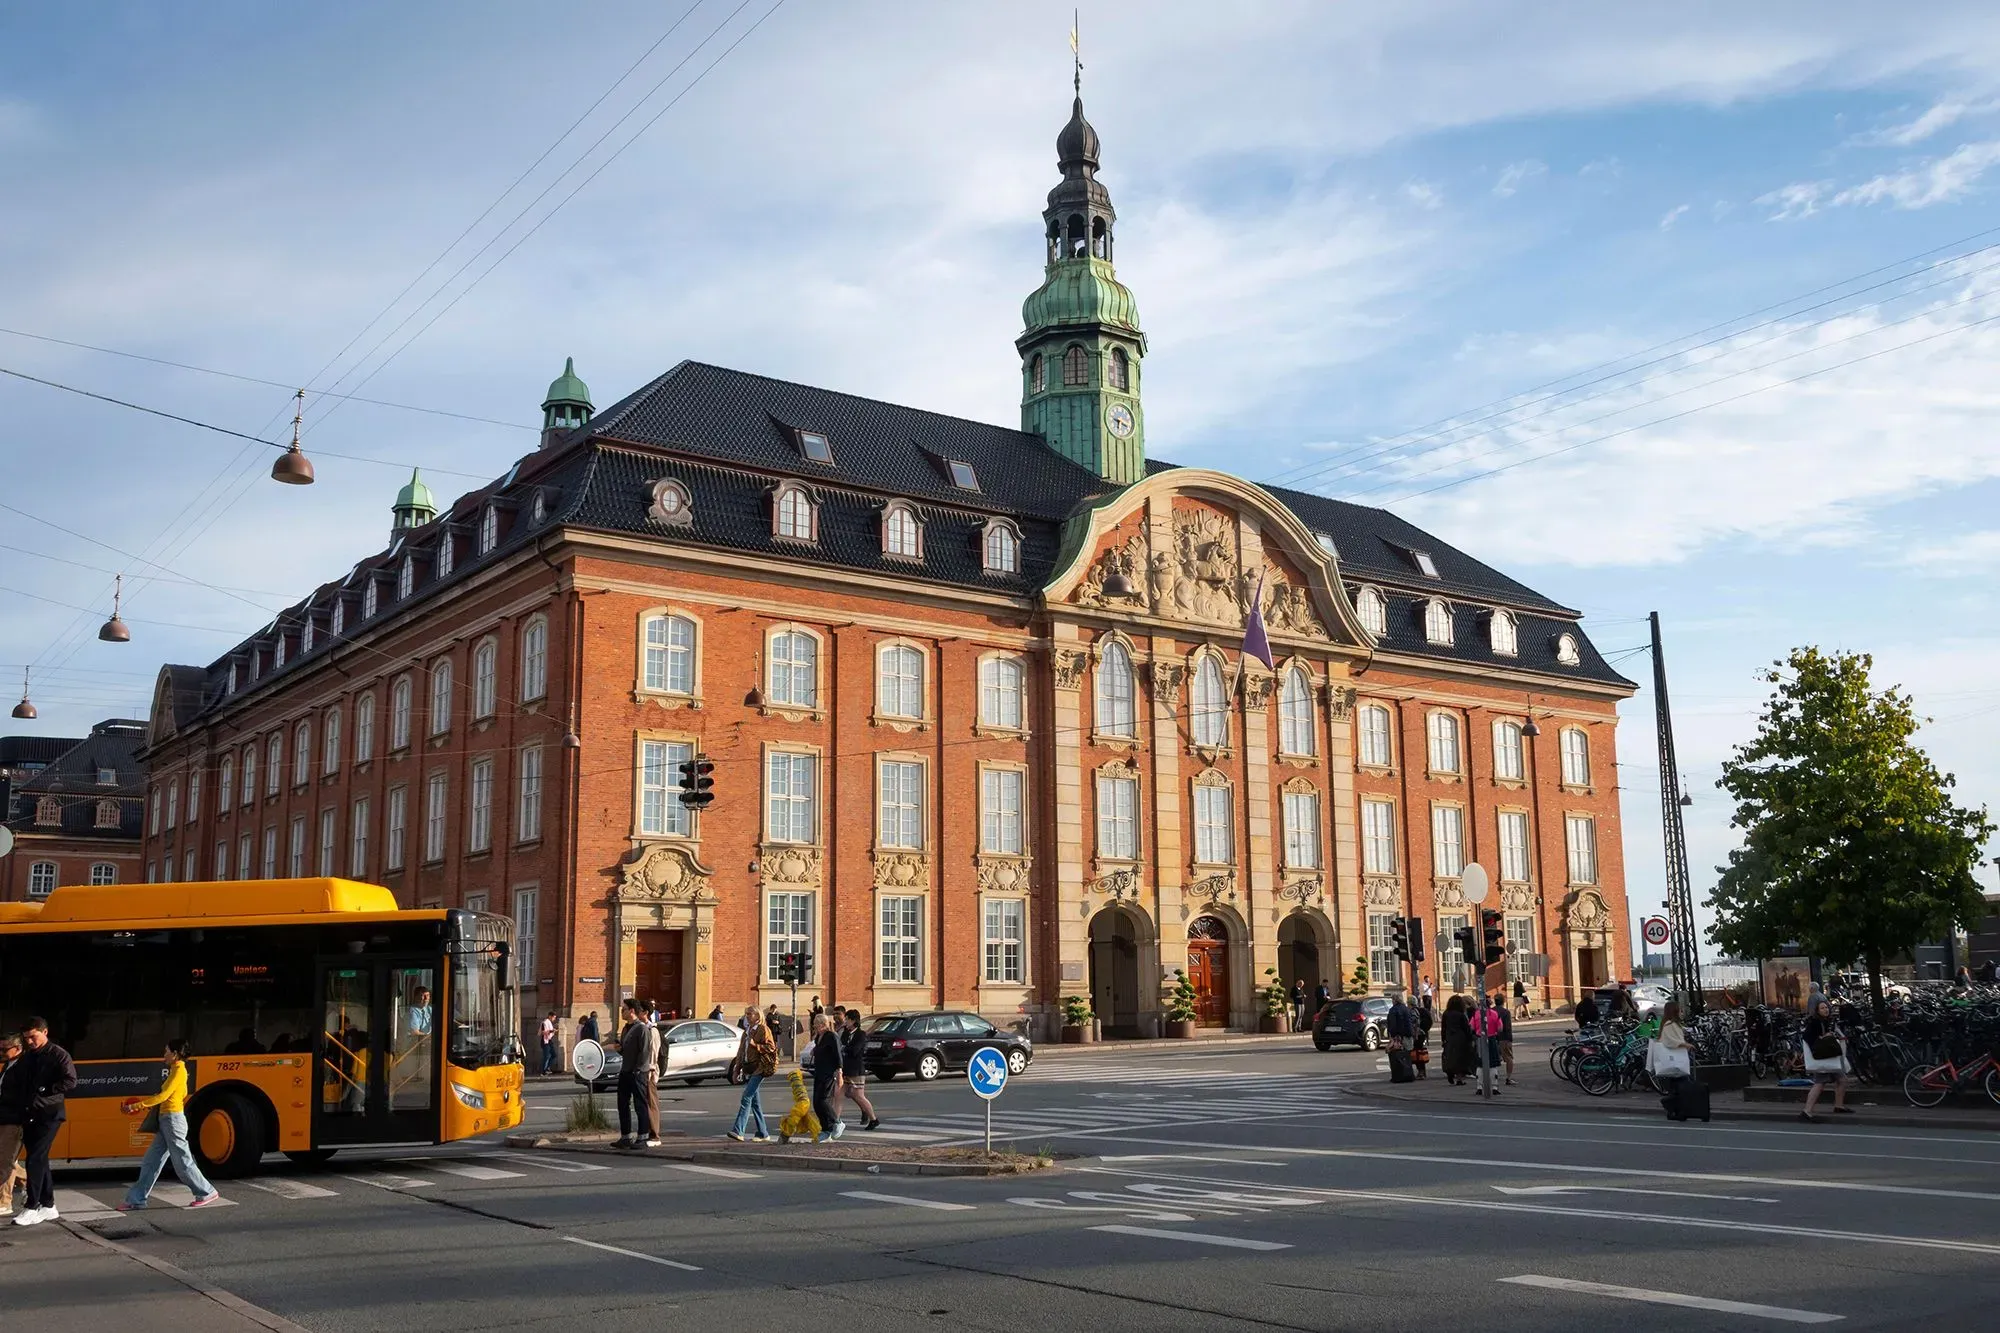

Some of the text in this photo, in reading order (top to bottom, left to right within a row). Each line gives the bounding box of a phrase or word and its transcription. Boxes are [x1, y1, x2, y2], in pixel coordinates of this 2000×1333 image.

[1648, 926, 1664, 937] 40
[217, 1062, 241, 1071] 7827
[92, 1077, 106, 1085] pris
[118, 1075, 149, 1084] Amager
